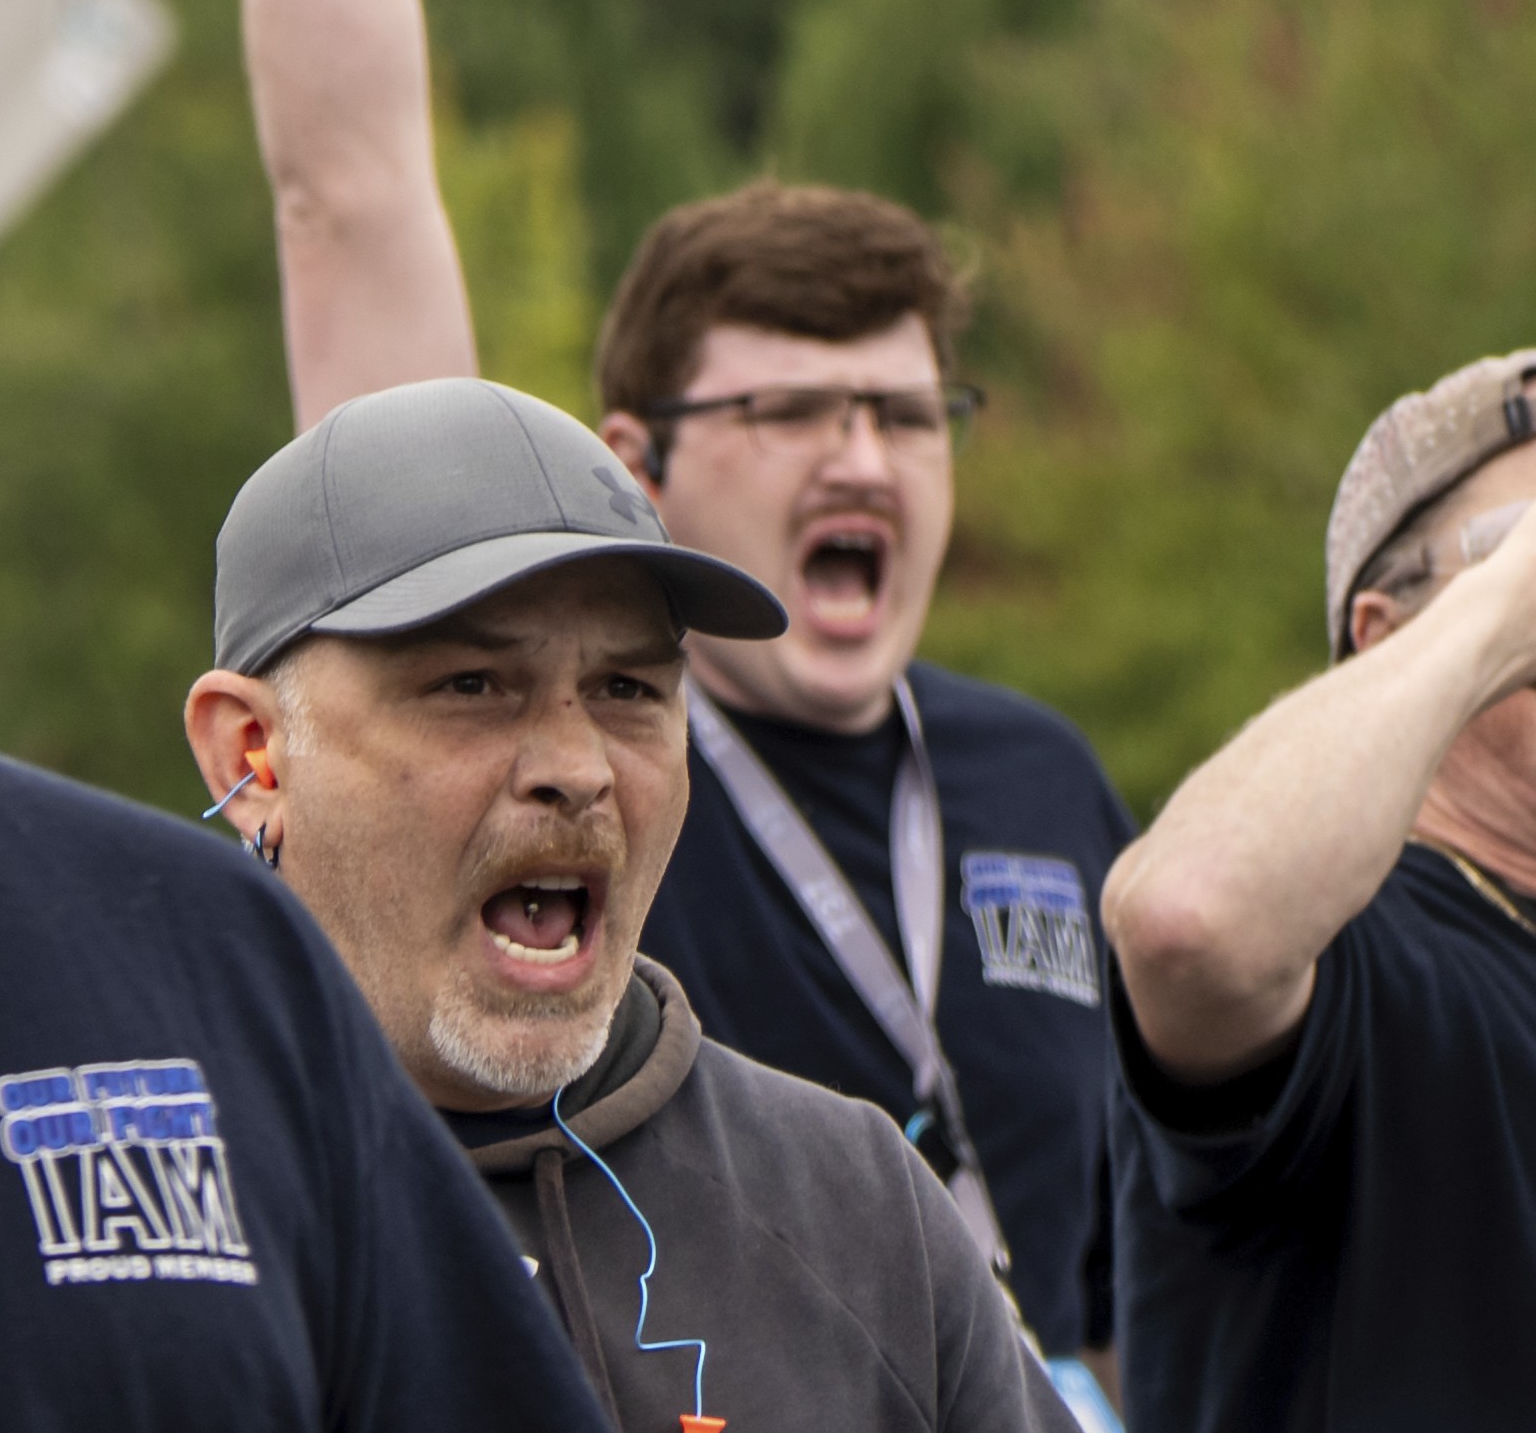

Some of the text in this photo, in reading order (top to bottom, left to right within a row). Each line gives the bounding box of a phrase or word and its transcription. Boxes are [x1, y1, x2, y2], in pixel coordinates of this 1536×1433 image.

[6, 1110, 96, 1157] OUR
[18, 1137, 250, 1257] IAM
[46, 1255, 258, 1285] PROUD MEMBER
